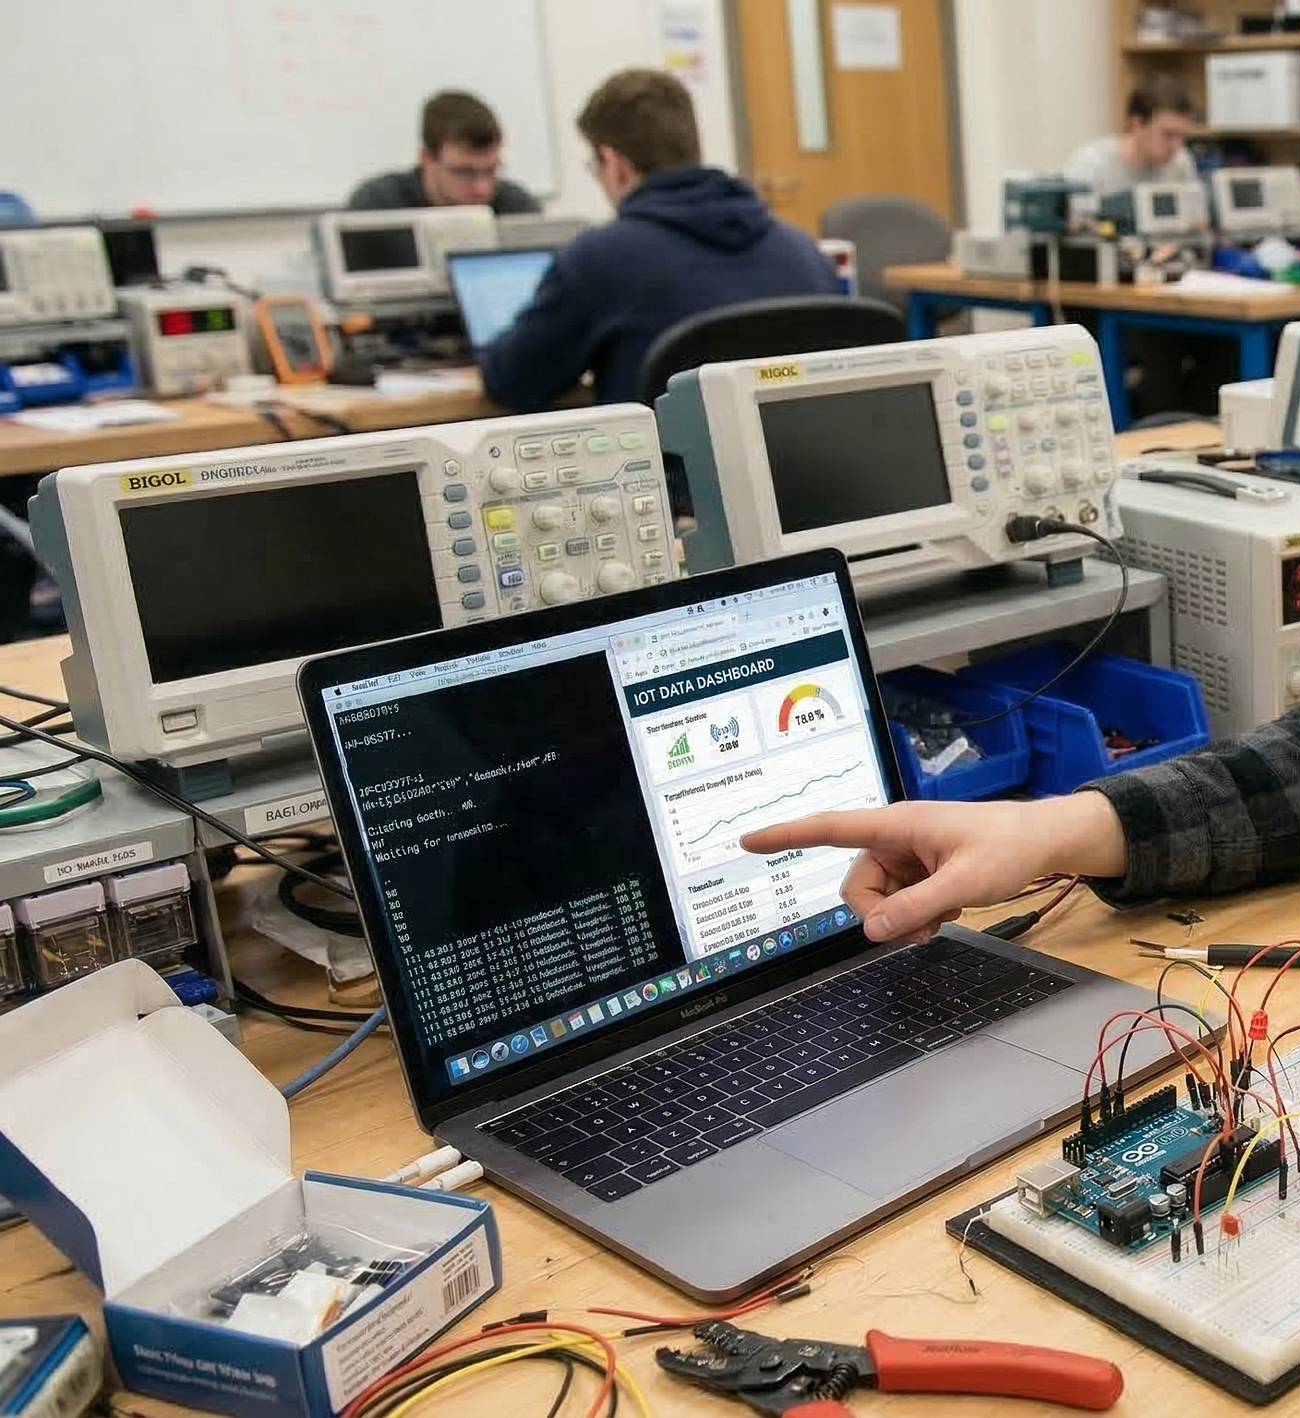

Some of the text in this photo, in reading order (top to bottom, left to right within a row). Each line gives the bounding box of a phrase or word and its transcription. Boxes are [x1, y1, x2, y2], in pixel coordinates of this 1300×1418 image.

[633, 657, 775, 706] IOT DATA DASHBOARD
